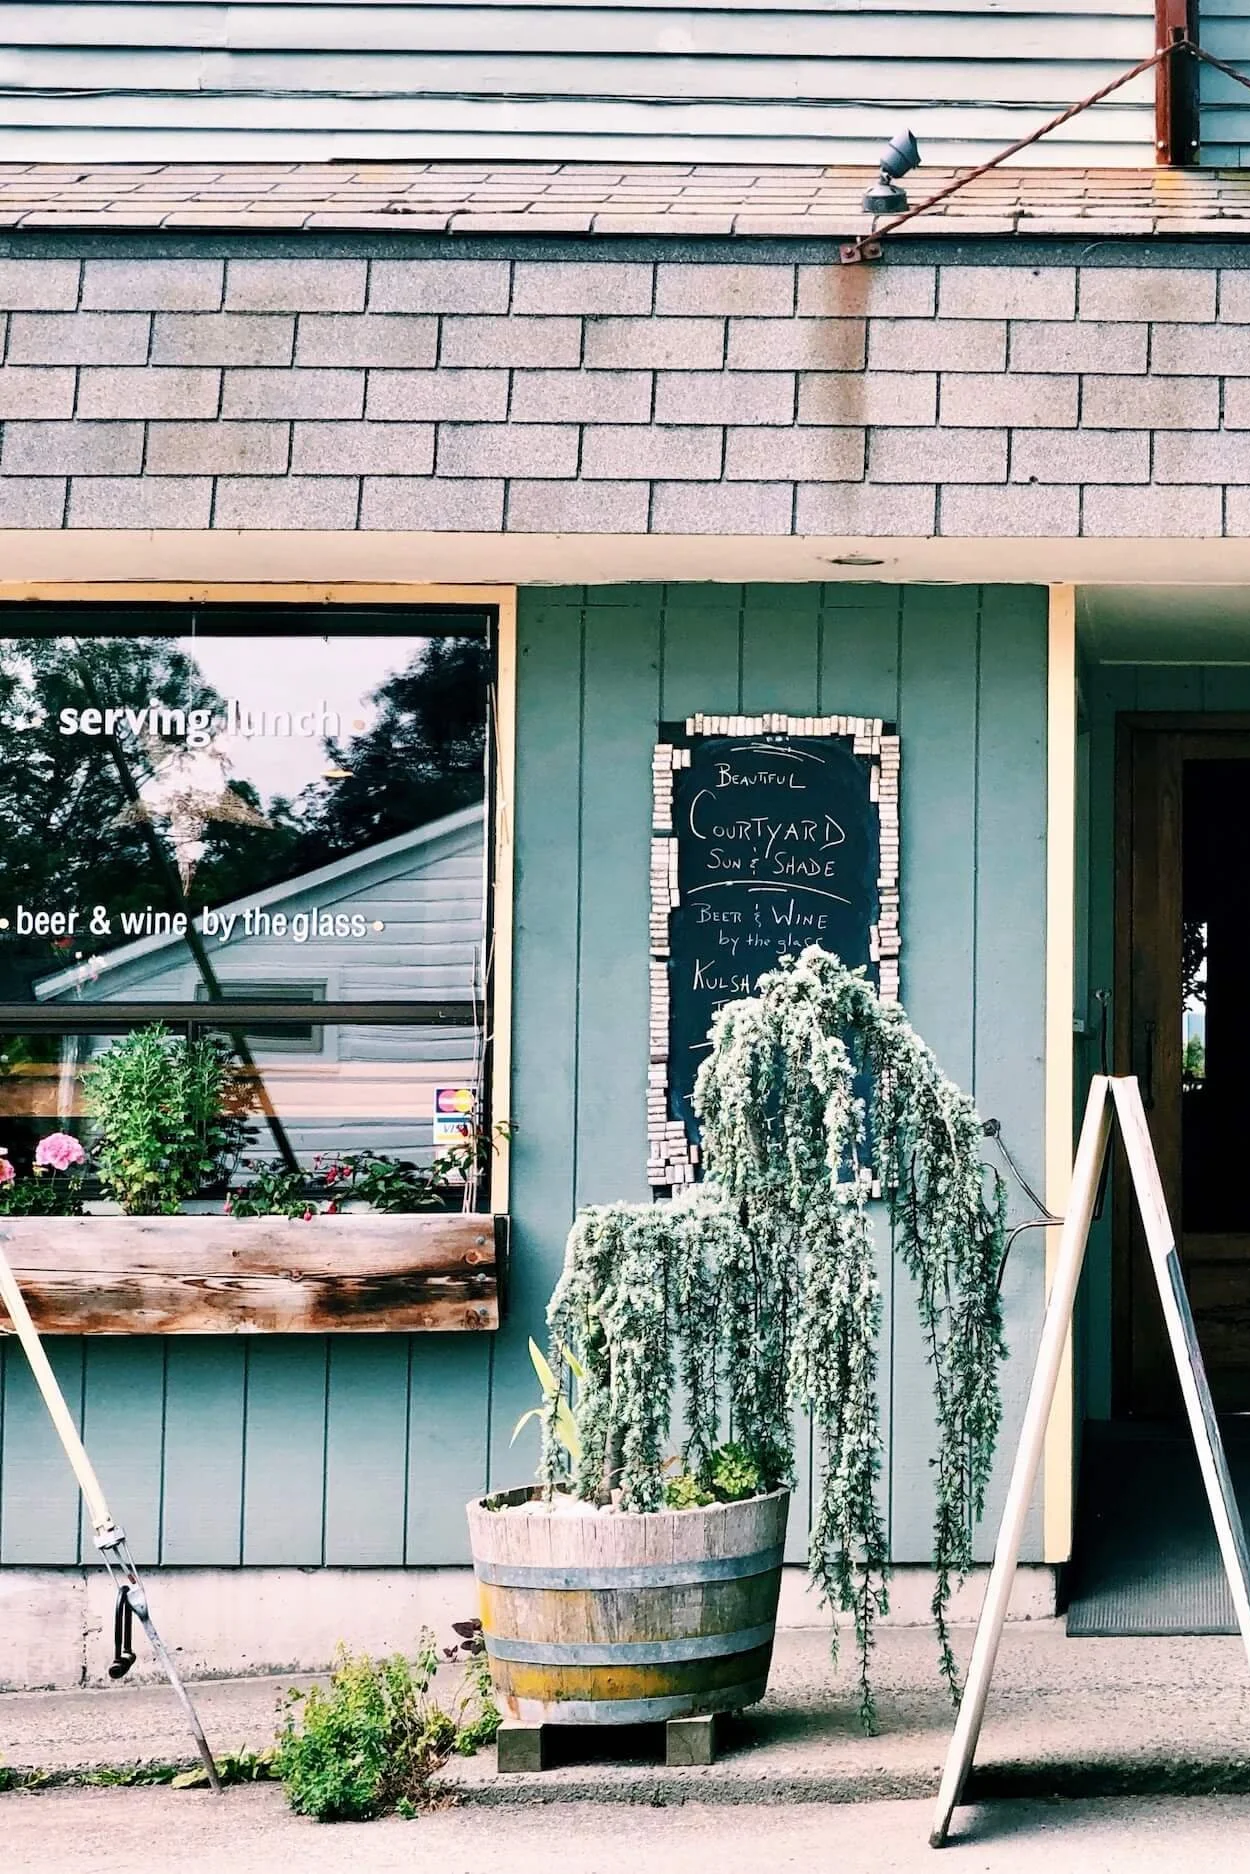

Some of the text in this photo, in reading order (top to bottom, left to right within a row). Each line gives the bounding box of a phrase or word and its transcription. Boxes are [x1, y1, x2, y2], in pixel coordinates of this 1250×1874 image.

[60, 697, 342, 747] serving lunch
[773, 851, 835, 877] SHADE
[16, 905, 366, 942] beer & wine by the glass
[772, 899, 828, 929] WINE
[719, 929, 740, 956] by
[746, 933, 771, 947] the
[693, 959, 765, 995] KULSHA
